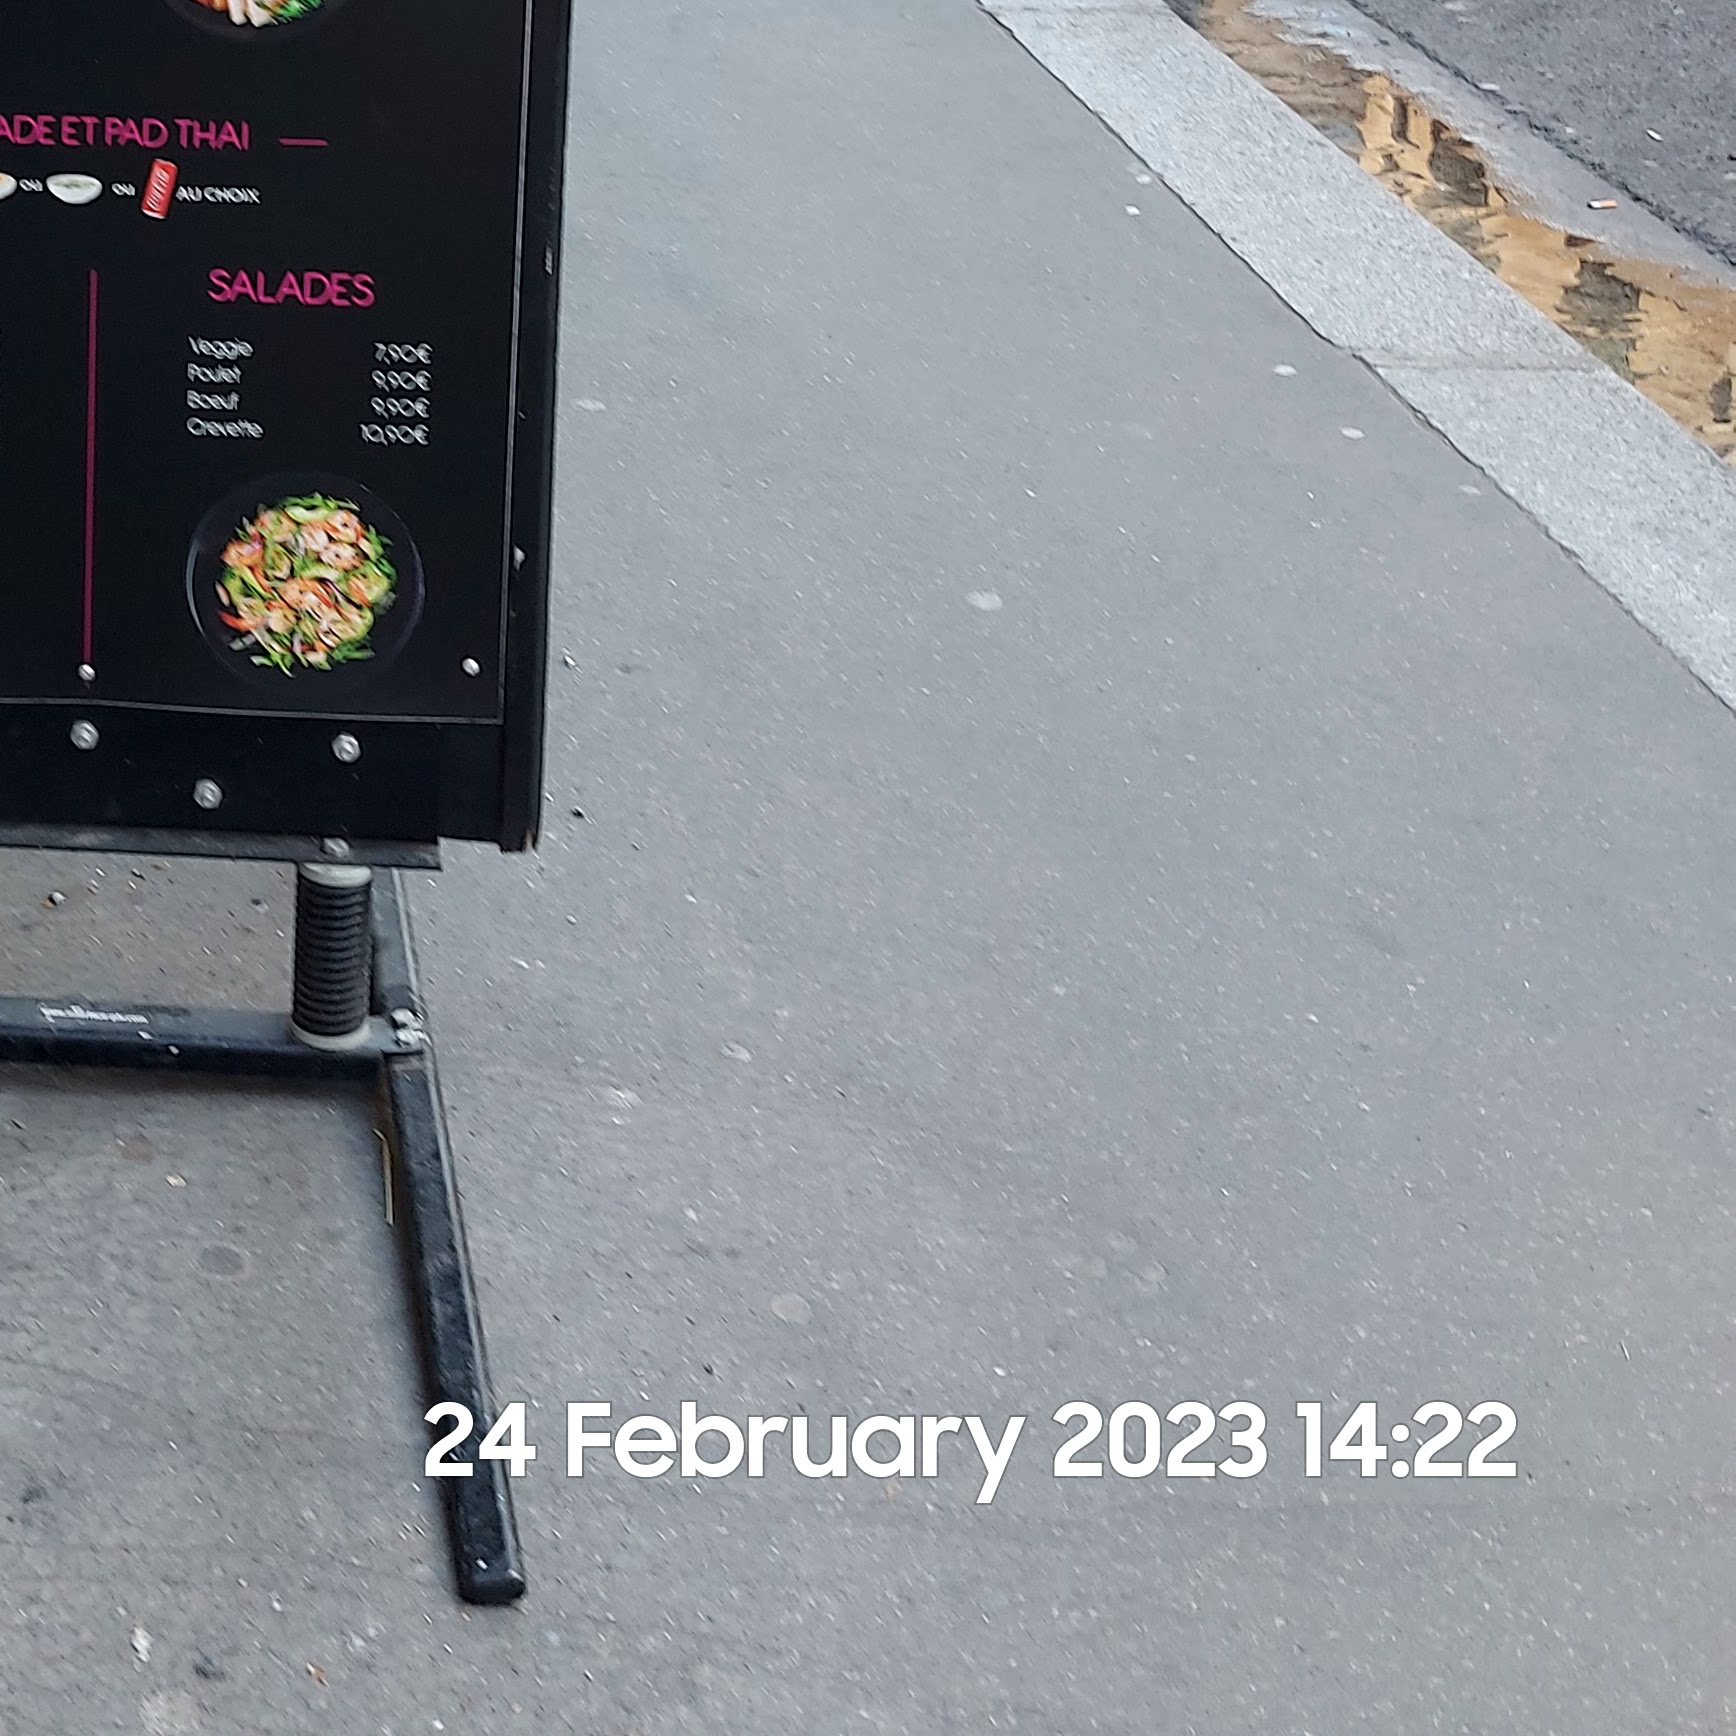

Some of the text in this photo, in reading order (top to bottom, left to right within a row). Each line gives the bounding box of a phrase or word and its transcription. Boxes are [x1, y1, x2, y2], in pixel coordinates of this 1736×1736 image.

[60, 114, 100, 147] ET
[104, 116, 166, 149] PAD
[173, 117, 250, 151] THAI
[175, 185, 202, 202] AU
[207, 267, 376, 308] SALADES
